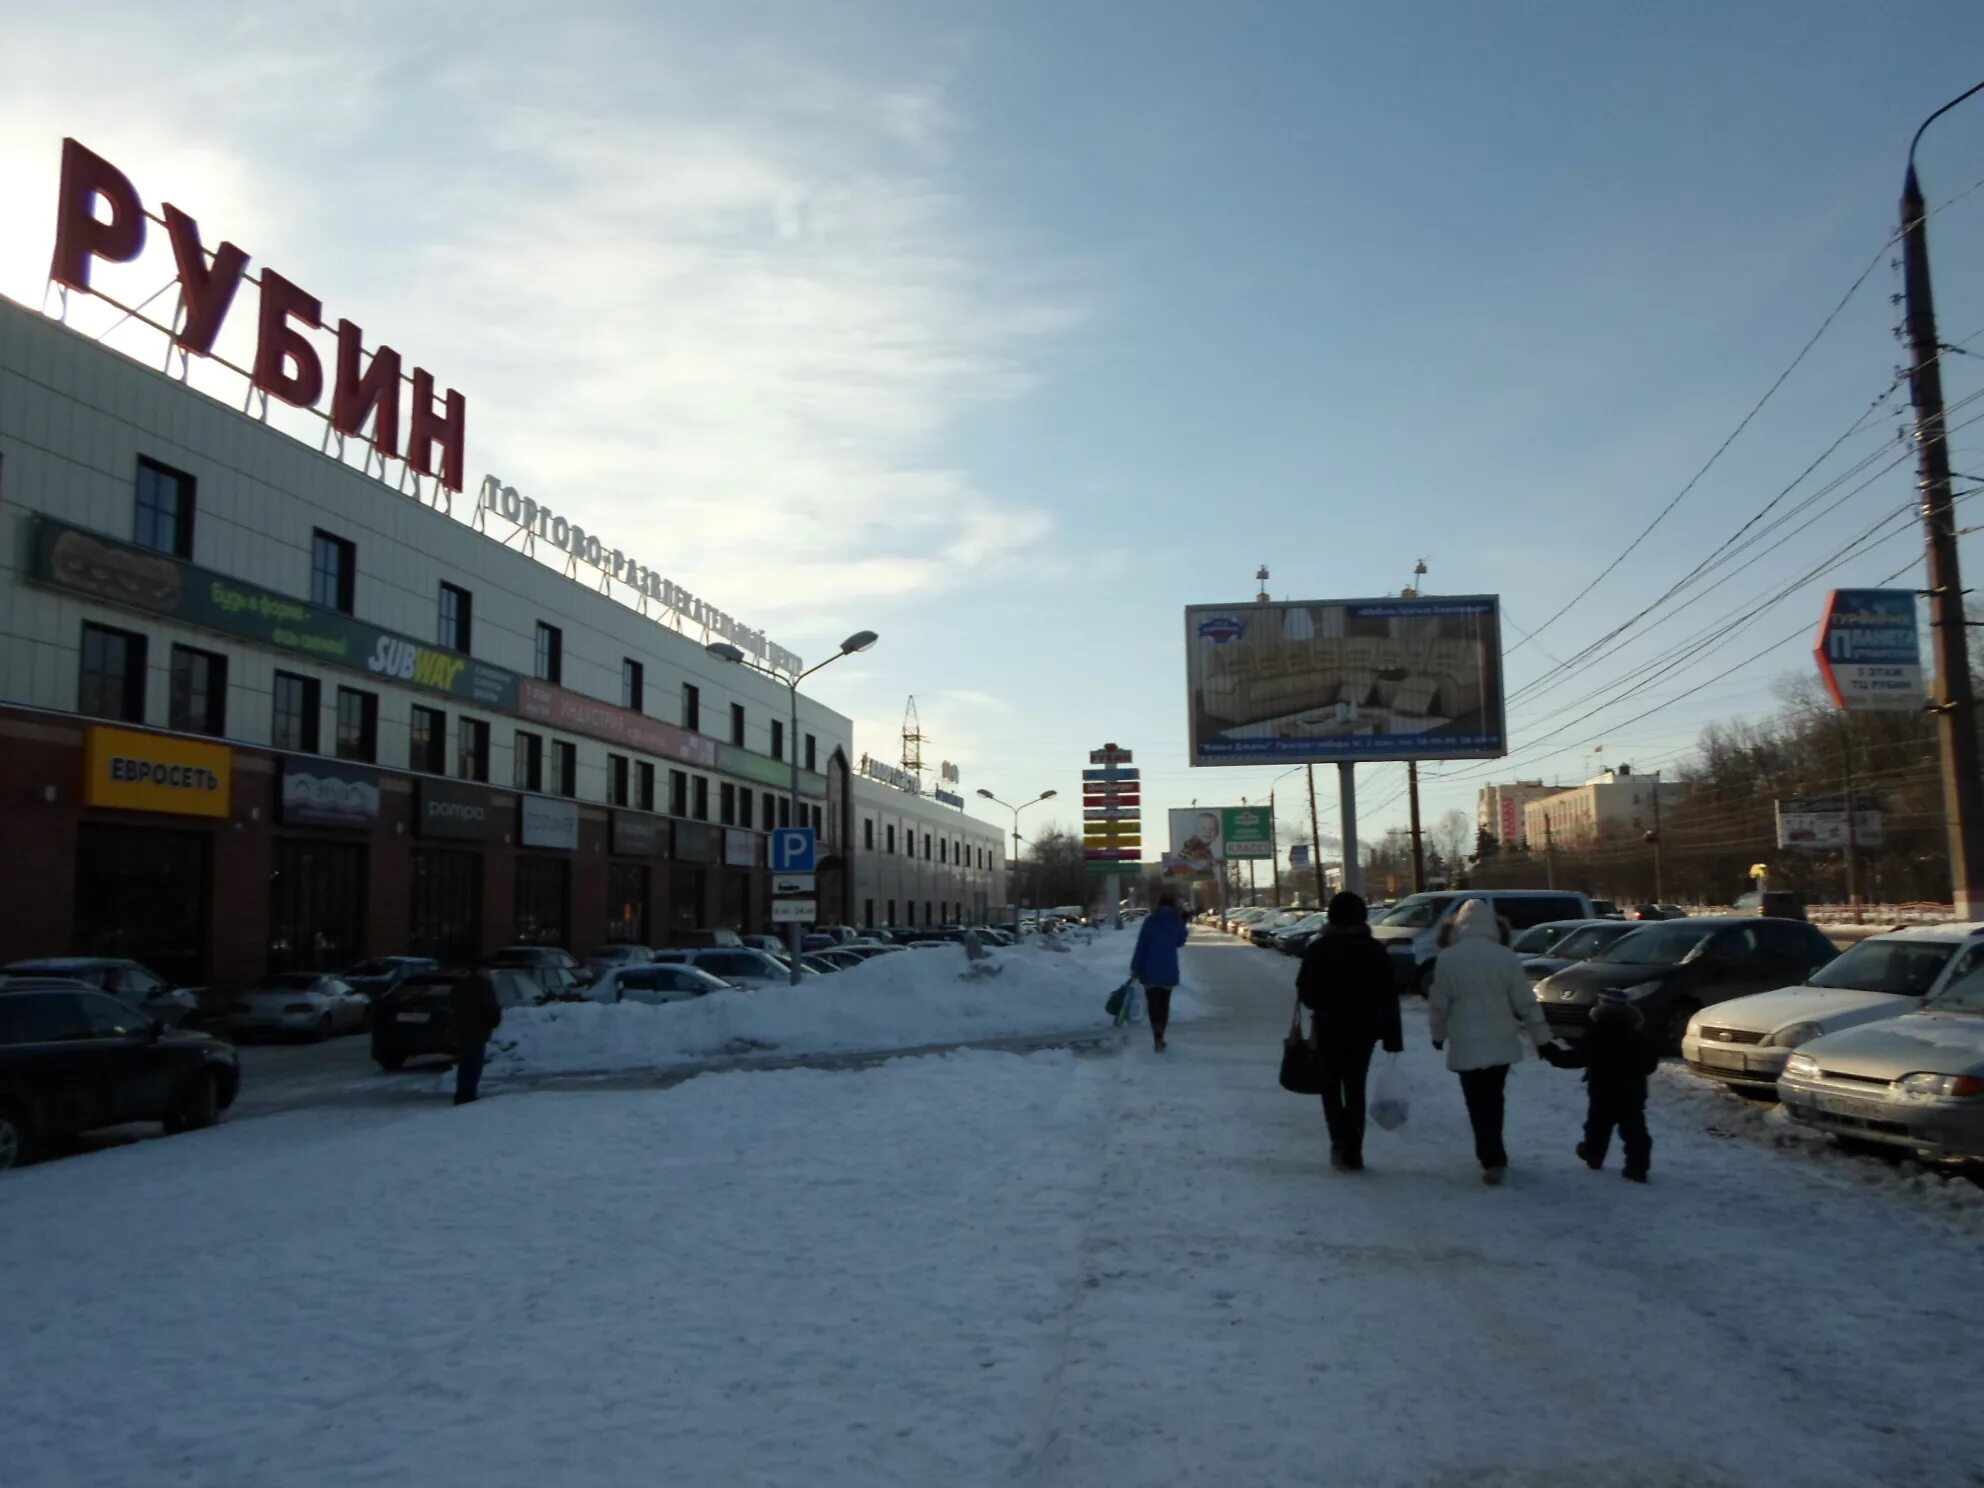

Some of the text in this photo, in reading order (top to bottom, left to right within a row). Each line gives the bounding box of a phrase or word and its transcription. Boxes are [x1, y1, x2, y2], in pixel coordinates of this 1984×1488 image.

[52, 136, 466, 493] РУБИН
[368, 635, 464, 692] SUBWAY
[110, 756, 219, 791] ЕВРОСЕТЬ
[428, 799, 485, 821] pompa
[783, 833, 808, 868] P
